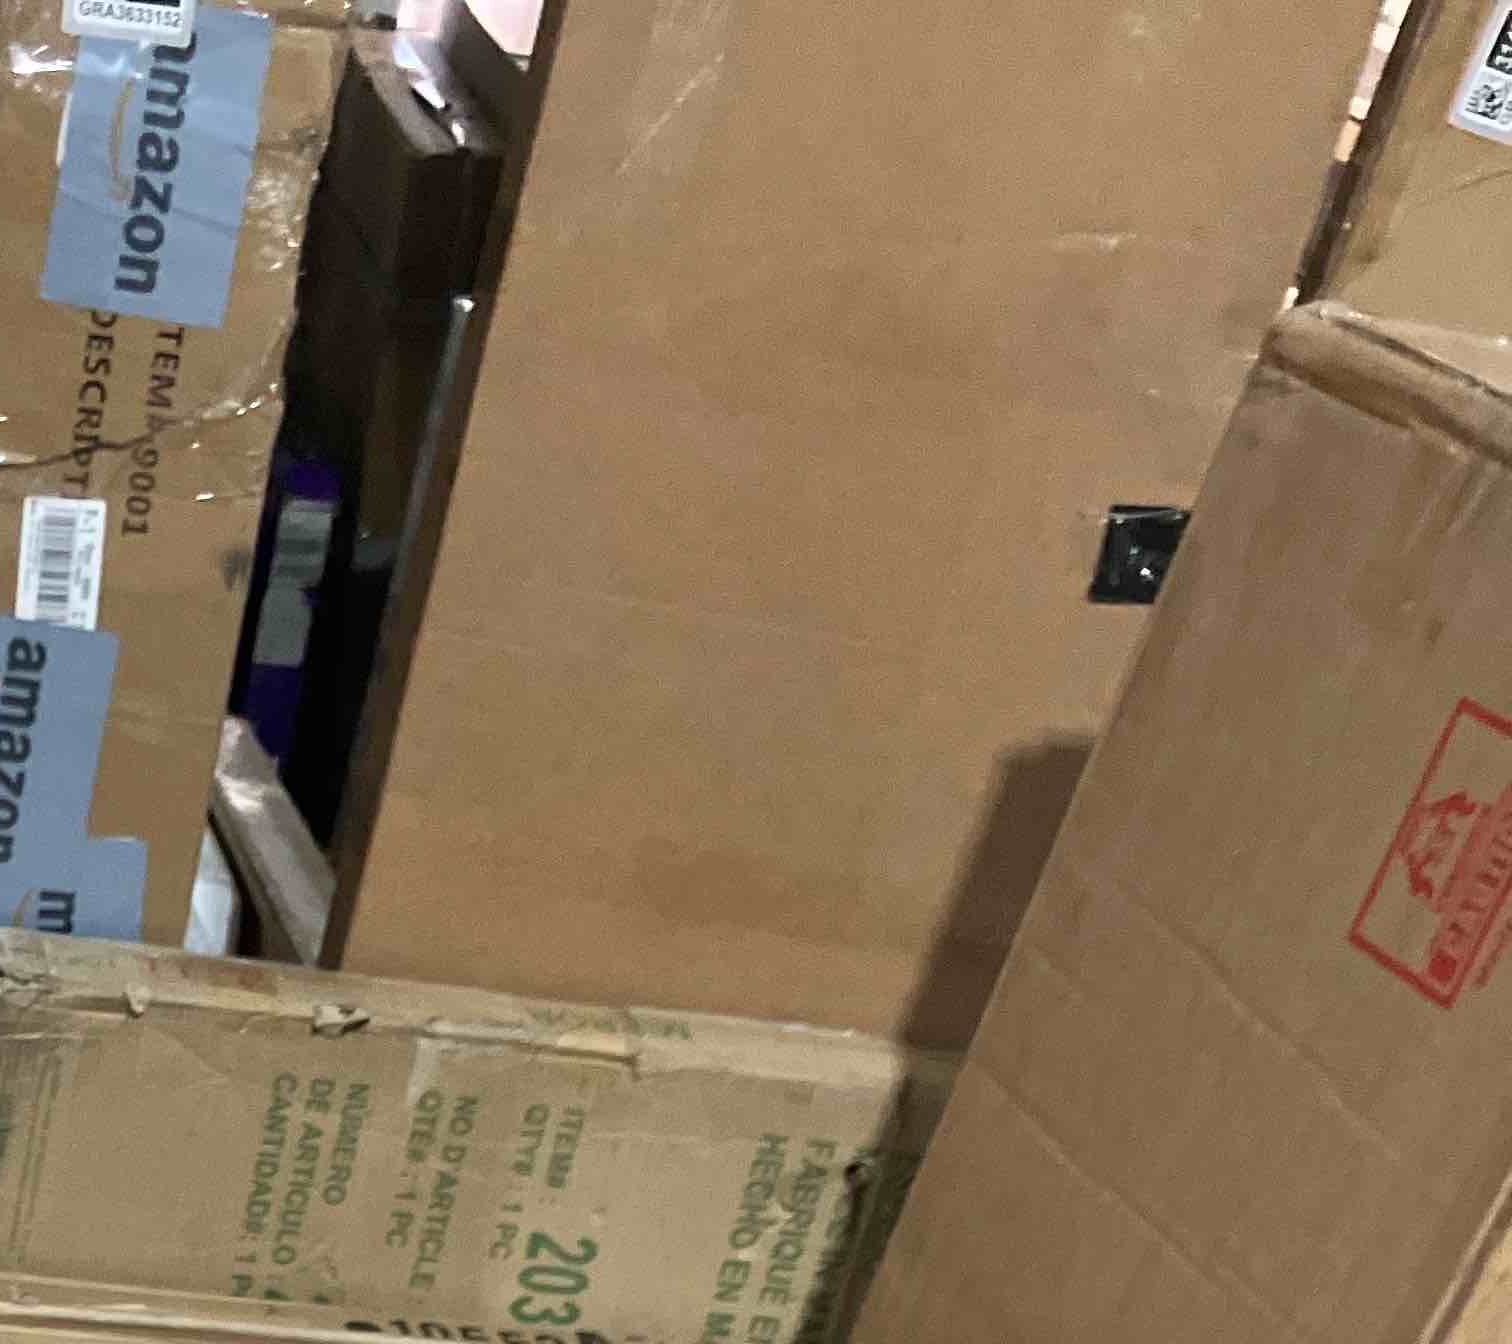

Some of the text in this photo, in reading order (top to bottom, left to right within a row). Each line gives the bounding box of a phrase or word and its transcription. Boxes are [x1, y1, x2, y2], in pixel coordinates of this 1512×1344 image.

[448, 1096, 479, 1136] NO
[386, 1209, 414, 1248] PC
[488, 1223, 521, 1260] PC
